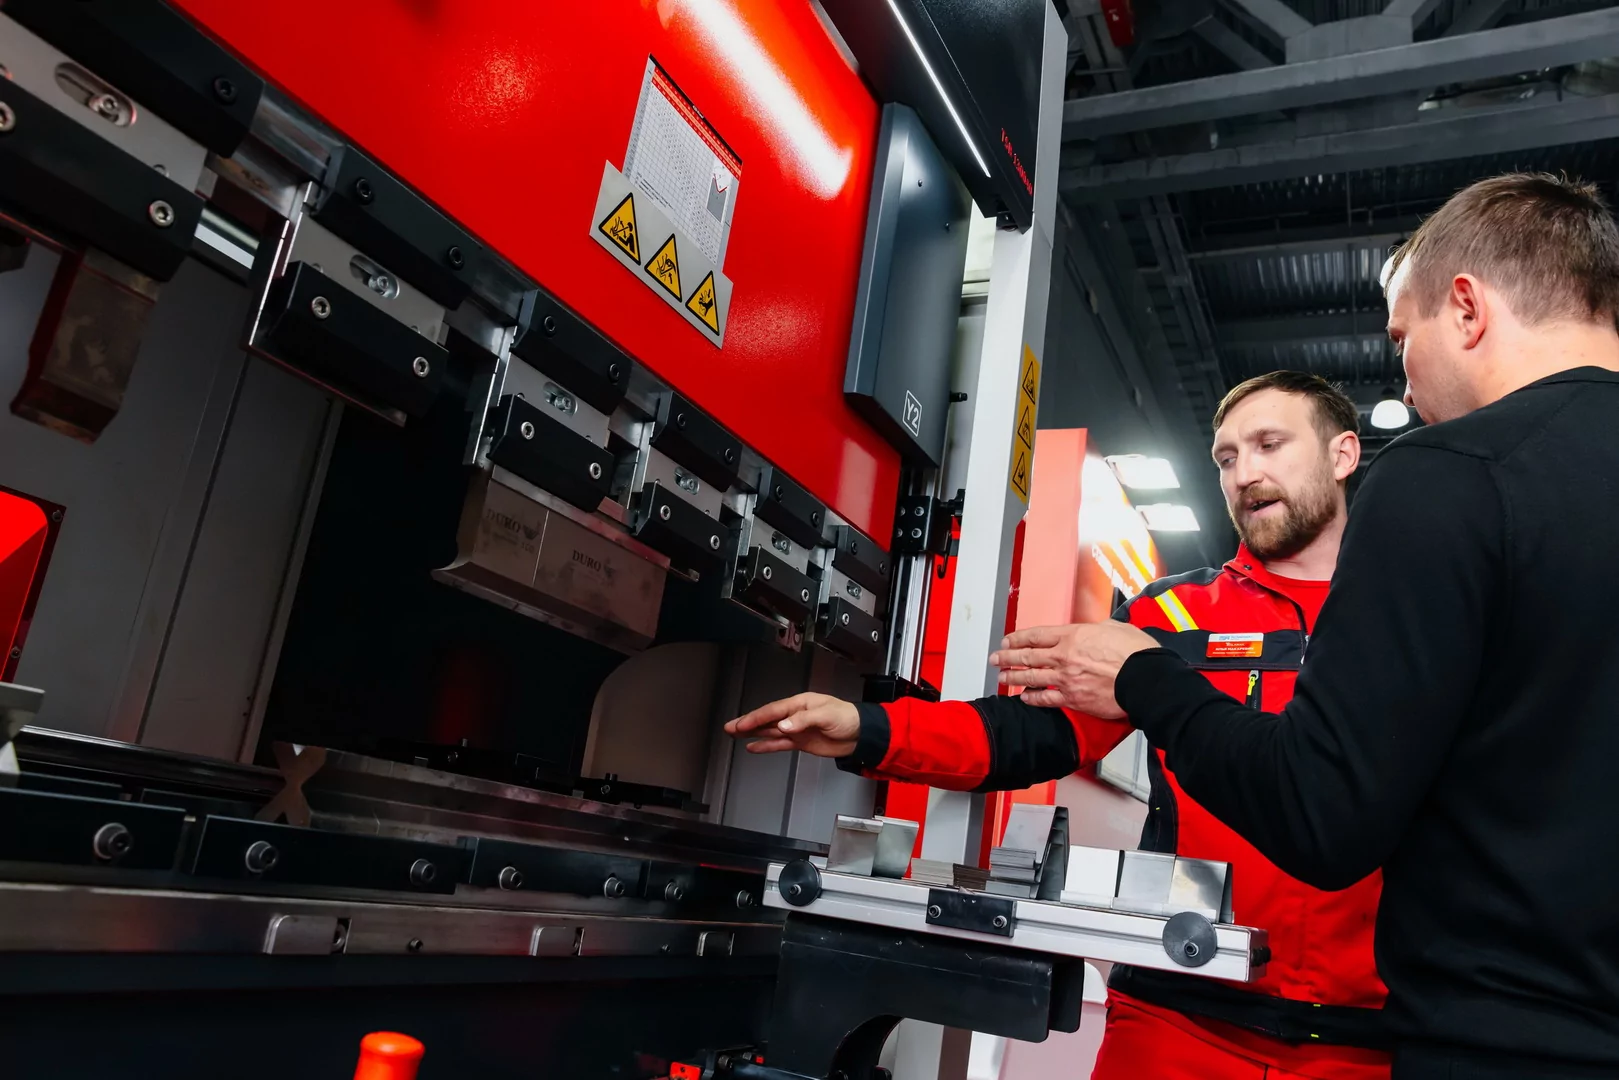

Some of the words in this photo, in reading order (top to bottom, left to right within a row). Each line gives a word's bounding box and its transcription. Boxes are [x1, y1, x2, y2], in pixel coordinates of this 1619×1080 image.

[907, 398, 919, 429] Y2
[486, 509, 521, 532] DURO
[572, 549, 601, 572] DURO
